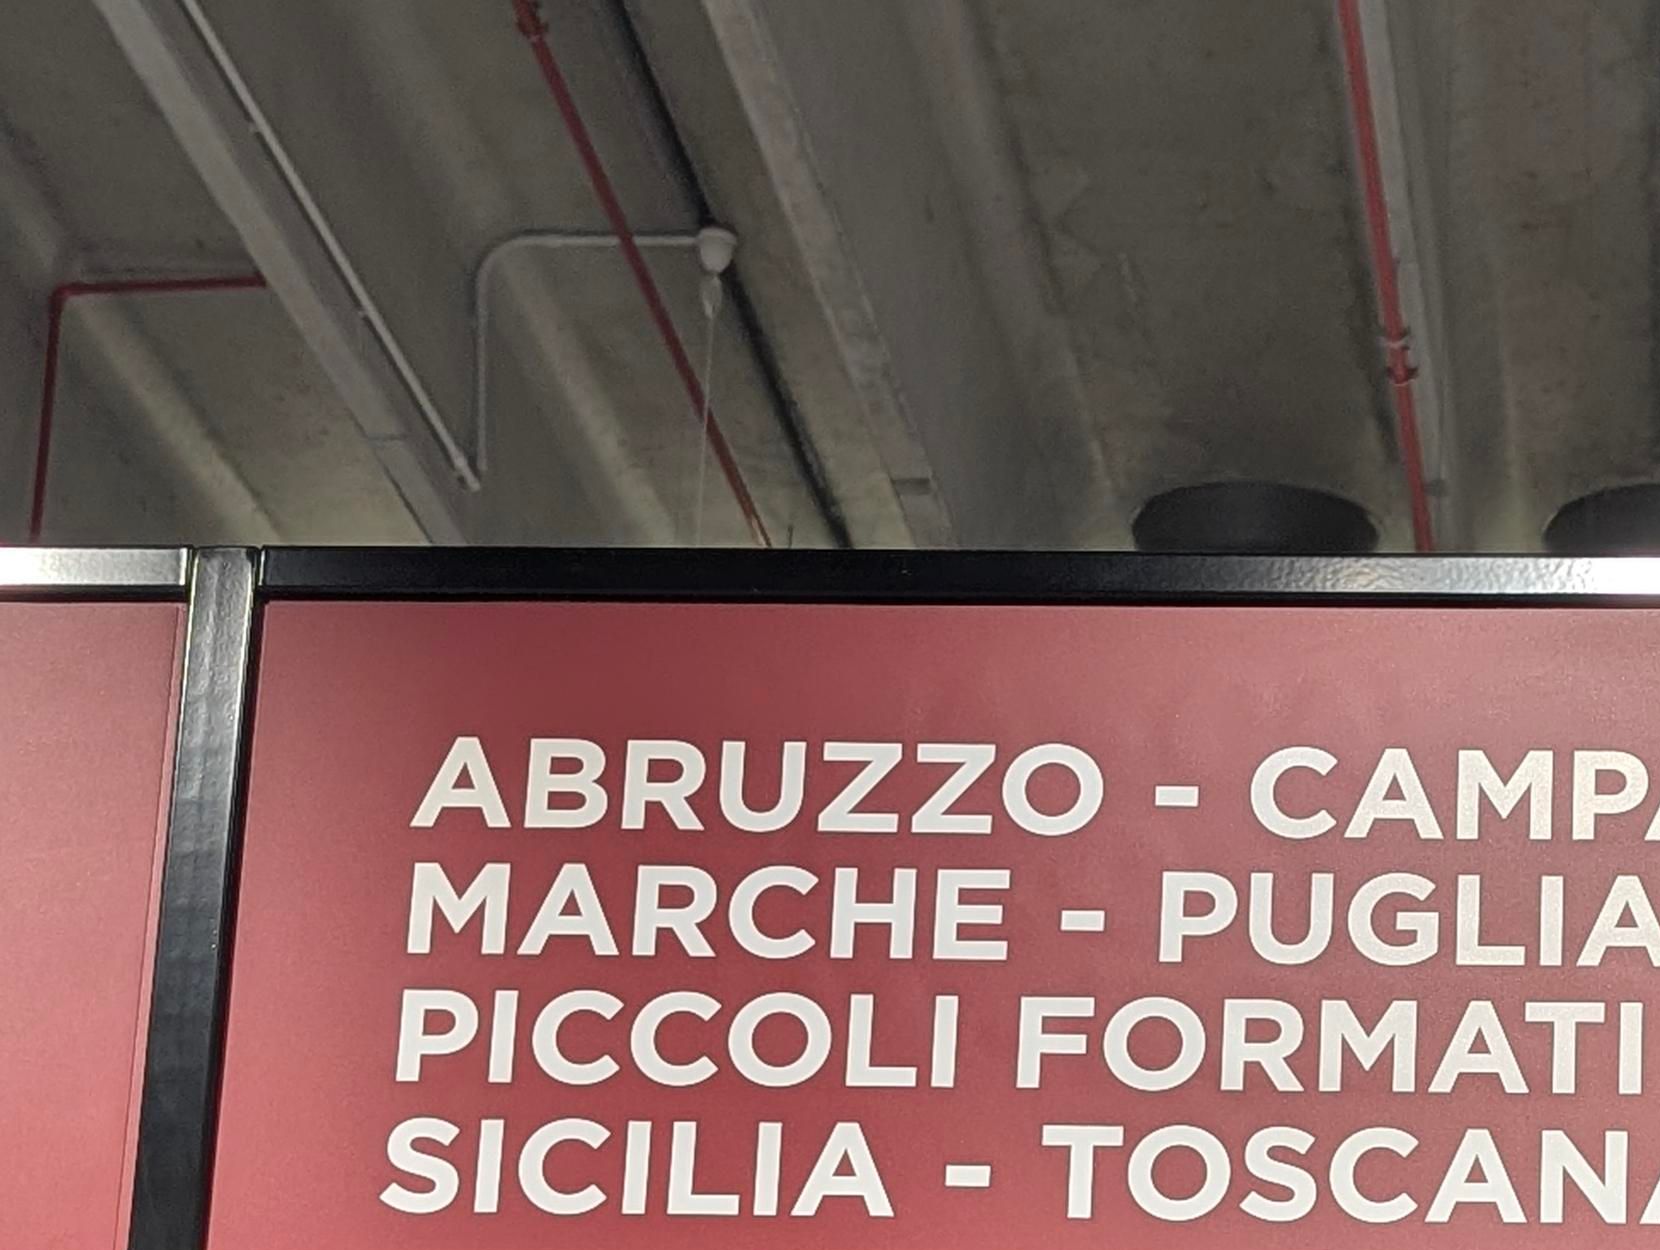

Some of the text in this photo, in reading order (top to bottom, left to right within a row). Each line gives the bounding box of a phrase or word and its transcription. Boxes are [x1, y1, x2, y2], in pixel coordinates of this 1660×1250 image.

[410, 737, 1103, 836] ABRUZZO
[408, 863, 1010, 960] MARCHE
[396, 989, 958, 1087] PICCOLI
[1016, 997, 1643, 1094] FORMATI
[380, 1118, 894, 1217] SICILIA
